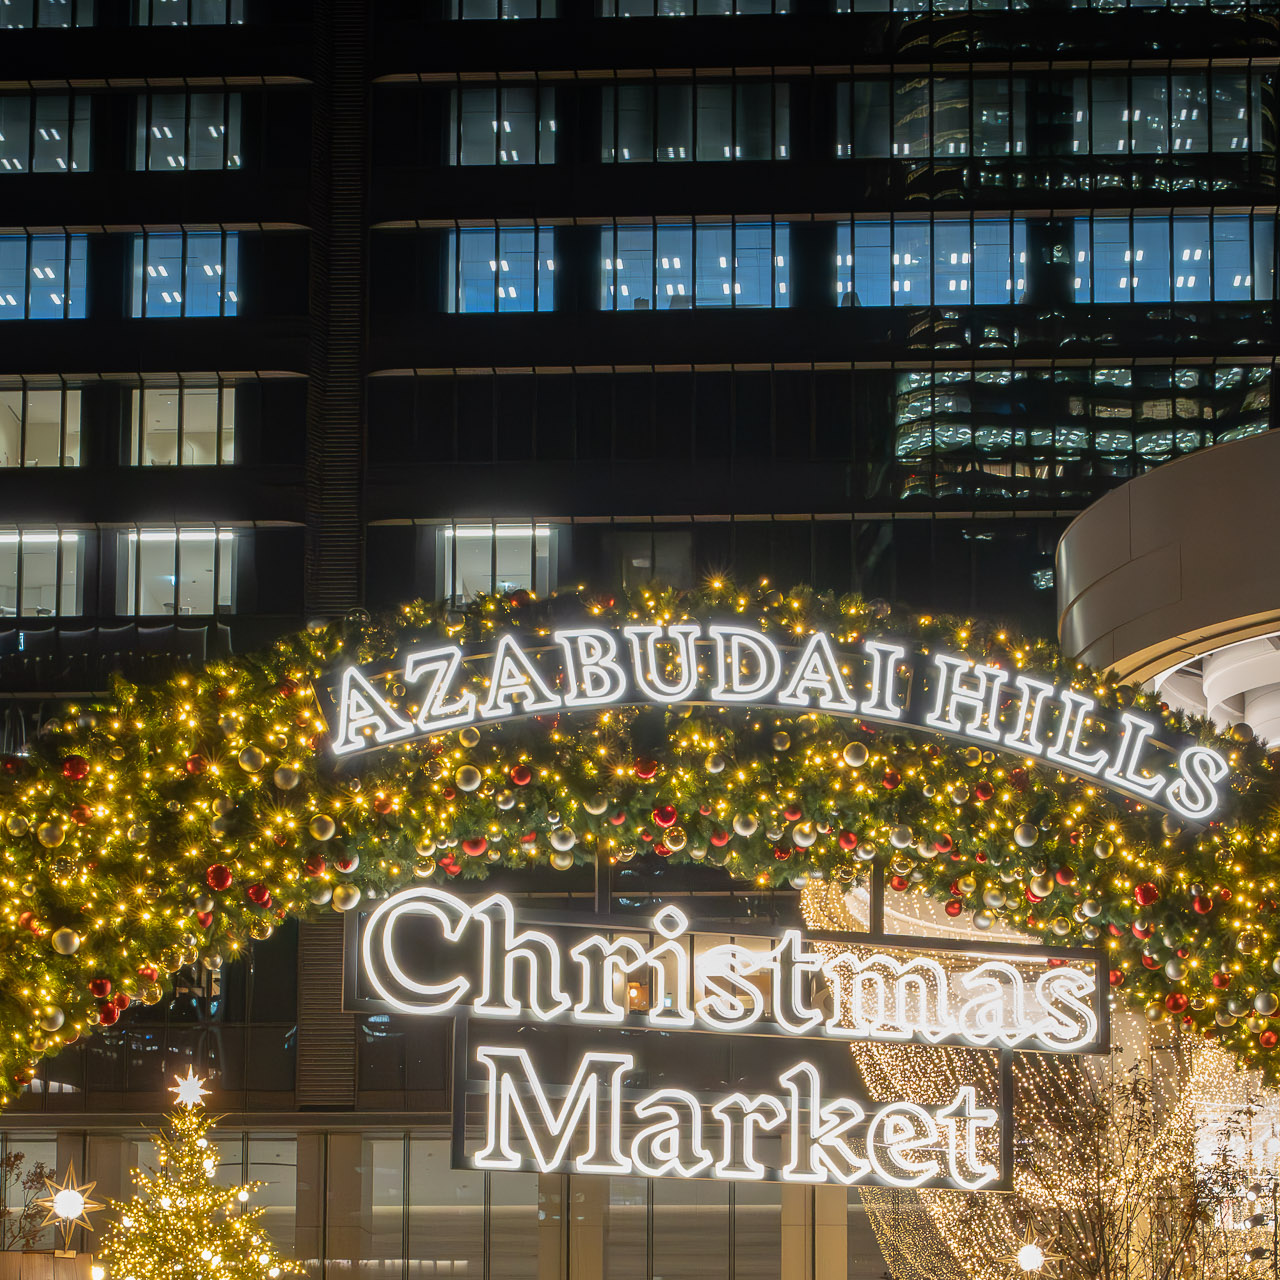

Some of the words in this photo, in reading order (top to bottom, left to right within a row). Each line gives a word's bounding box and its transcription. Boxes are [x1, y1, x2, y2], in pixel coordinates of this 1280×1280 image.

[331, 622, 906, 756] AZABUDAI
[923, 651, 1231, 820] HILLS
[361, 885, 1101, 1051] Christmas
[472, 1044, 1001, 1191] Market
